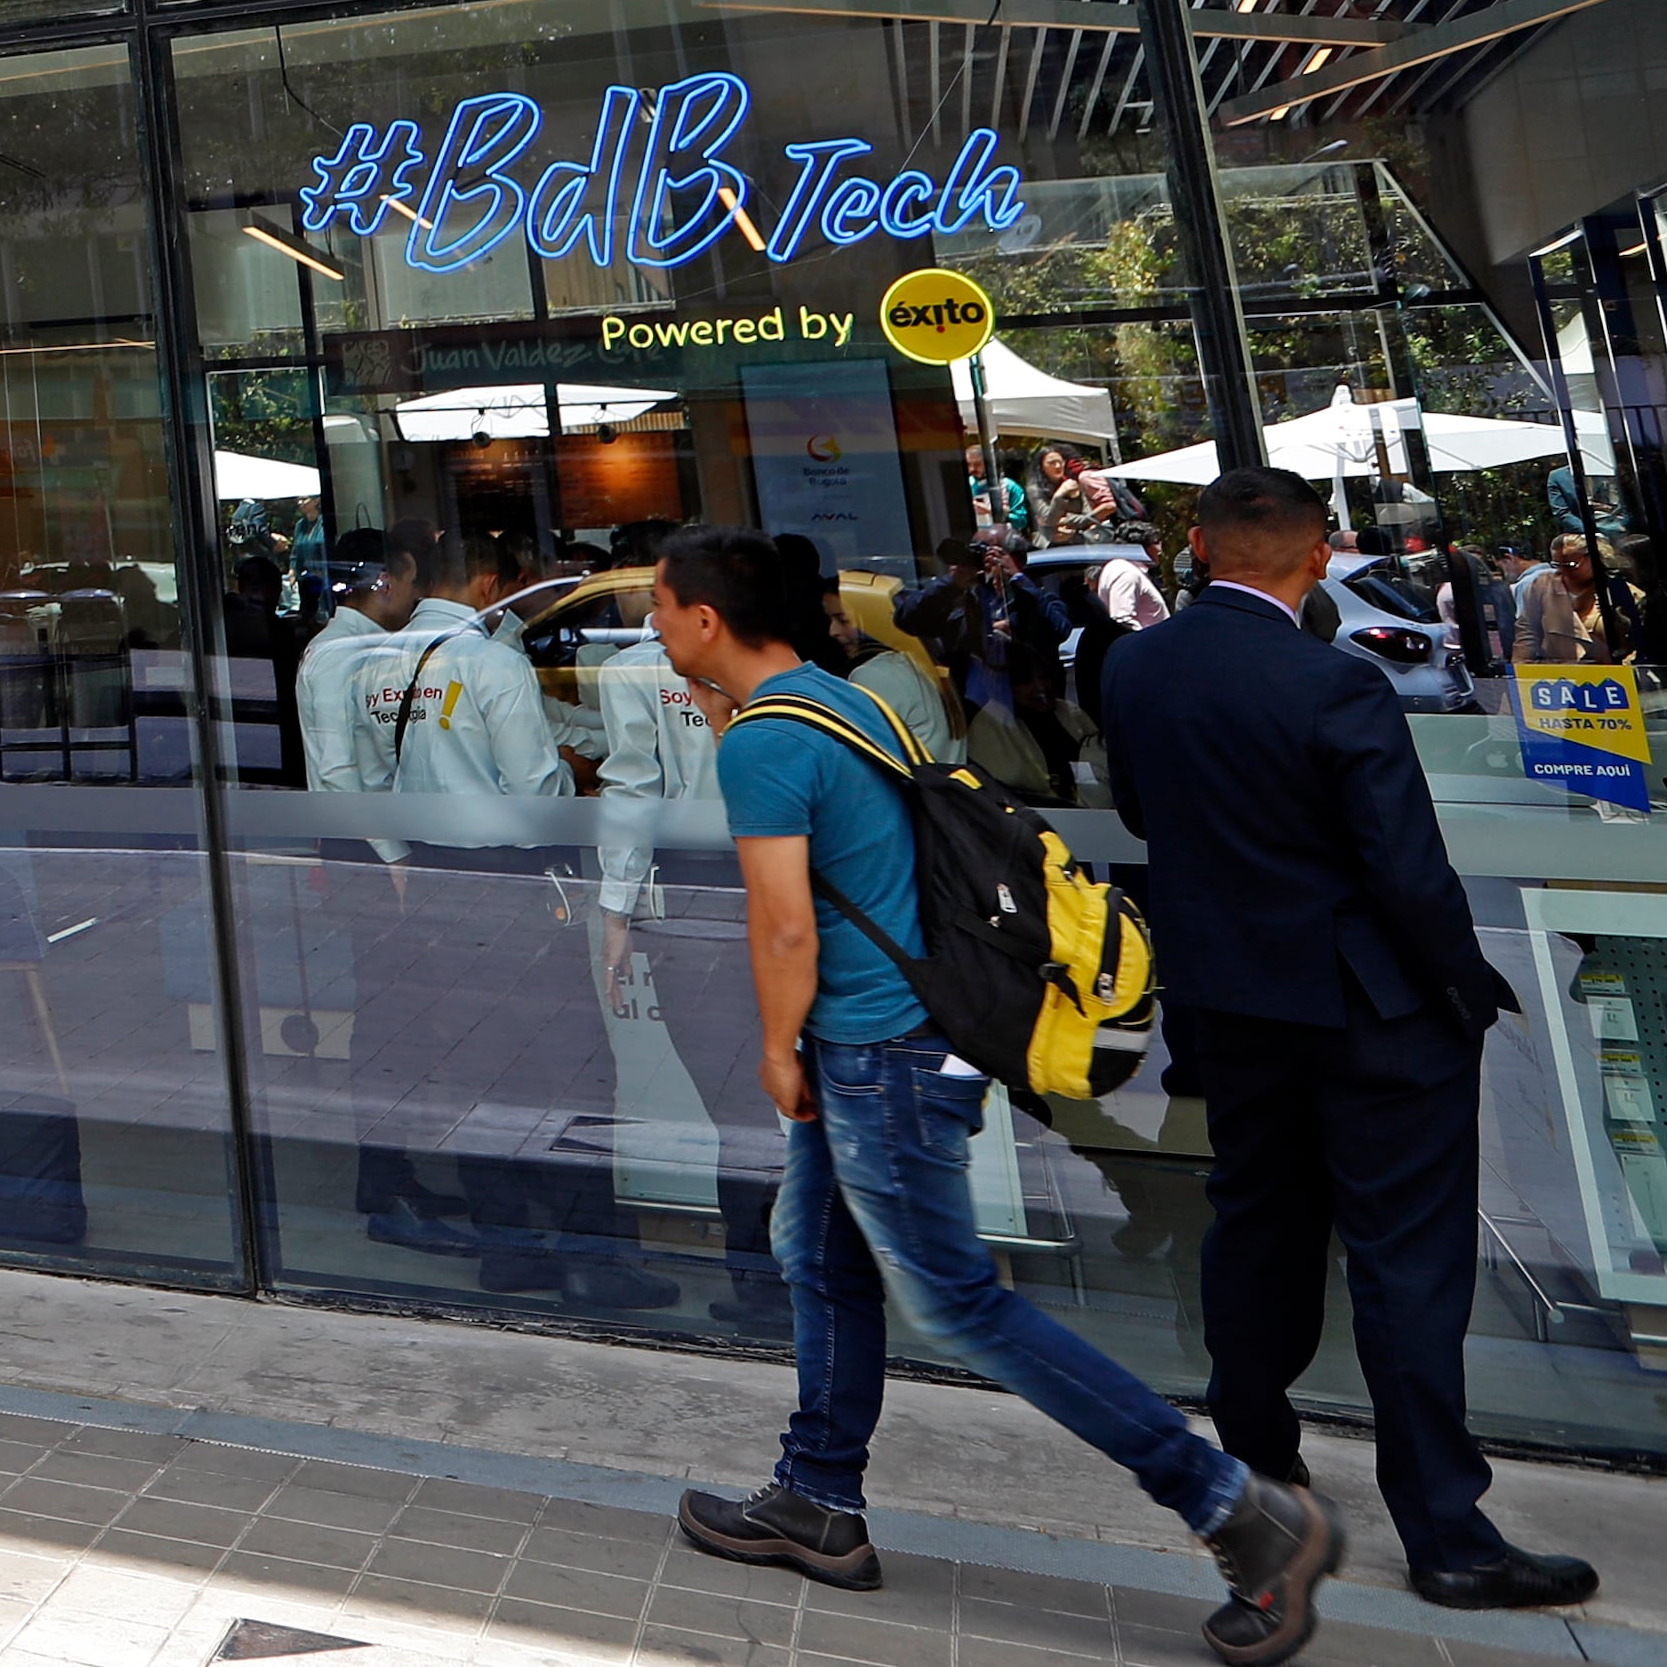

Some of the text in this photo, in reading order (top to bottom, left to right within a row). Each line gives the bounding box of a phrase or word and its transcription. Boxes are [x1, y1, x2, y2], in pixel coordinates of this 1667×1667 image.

[299, 70, 1025, 272] #BdB Tech
[601, 304, 855, 351] Powered by
[889, 297, 985, 333] éxito
[400, 342, 480, 375] Juan
[481, 338, 593, 372] Valdez
[660, 689, 692, 706] Soy
[1538, 685, 1621, 709] SALE
[1539, 718, 1633, 731] HASTA 70%
[1534, 764, 1594, 776] COMPRE
